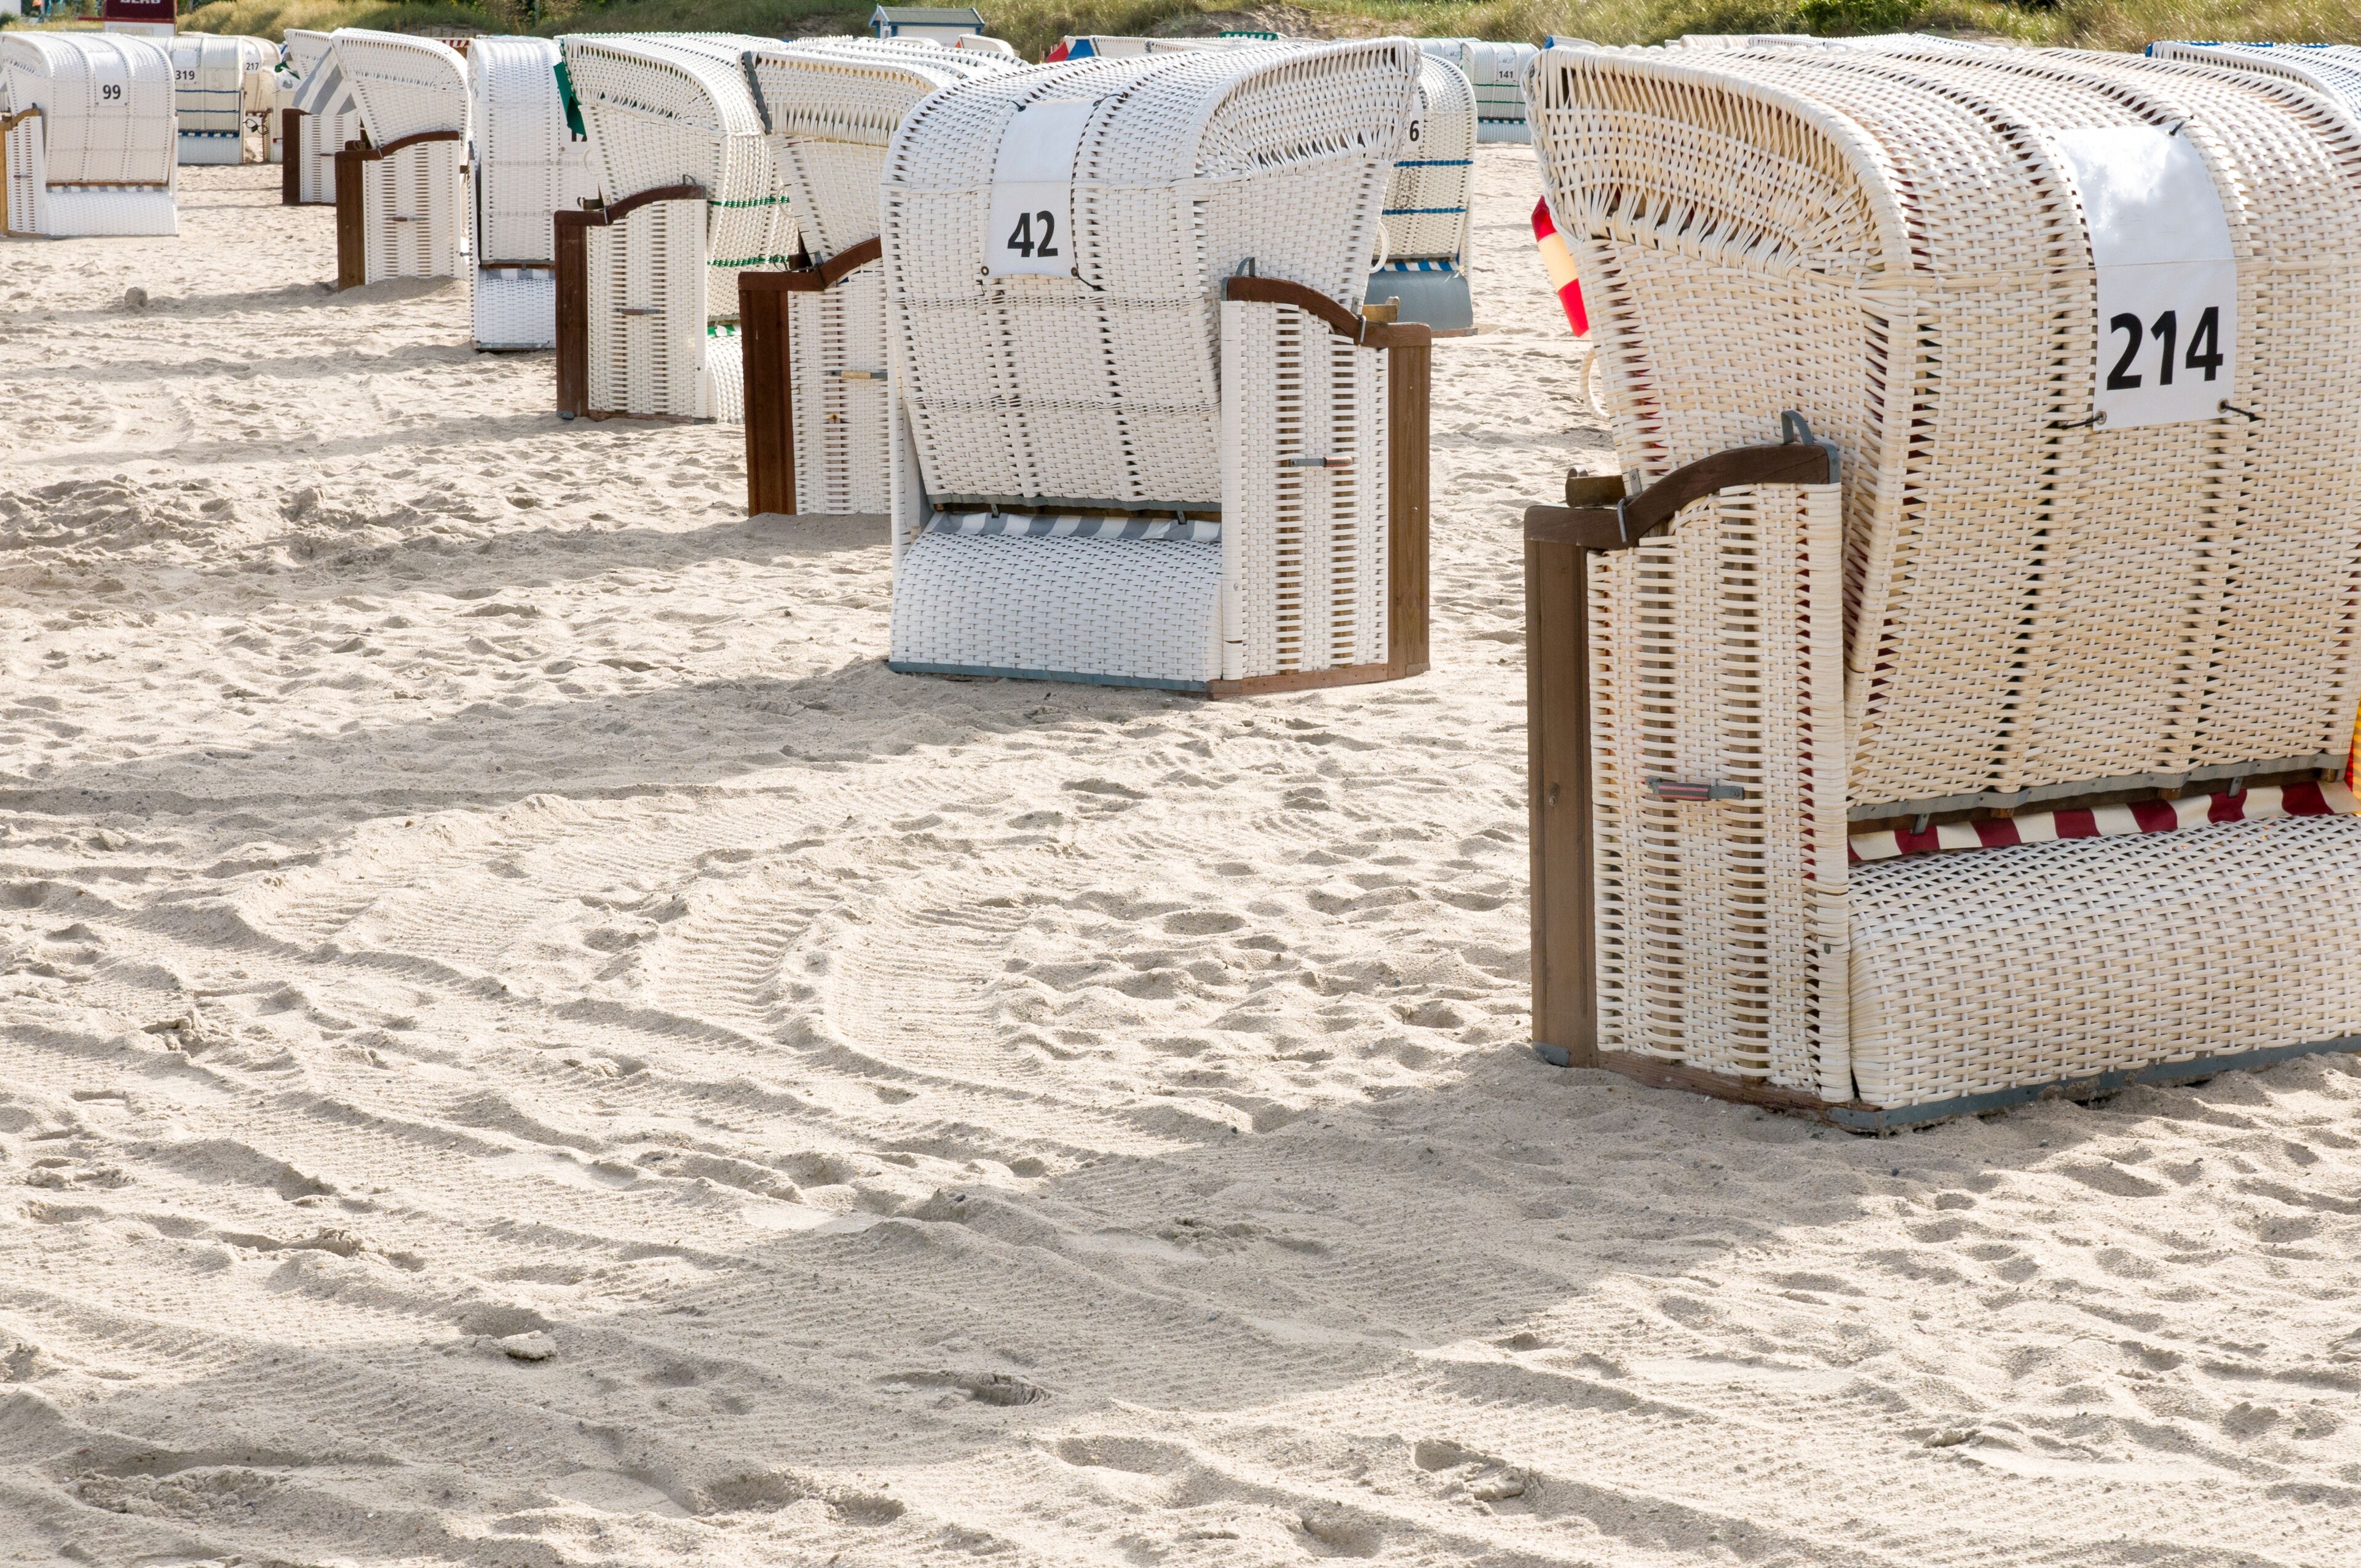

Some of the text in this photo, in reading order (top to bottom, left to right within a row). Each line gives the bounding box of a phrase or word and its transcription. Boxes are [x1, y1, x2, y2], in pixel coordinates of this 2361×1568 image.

[246, 62, 259, 71] 217
[175, 70, 195, 80] 319
[103, 84, 121, 100] 99
[1007, 210, 1058, 258] 42
[2106, 306, 2223, 390] 214
